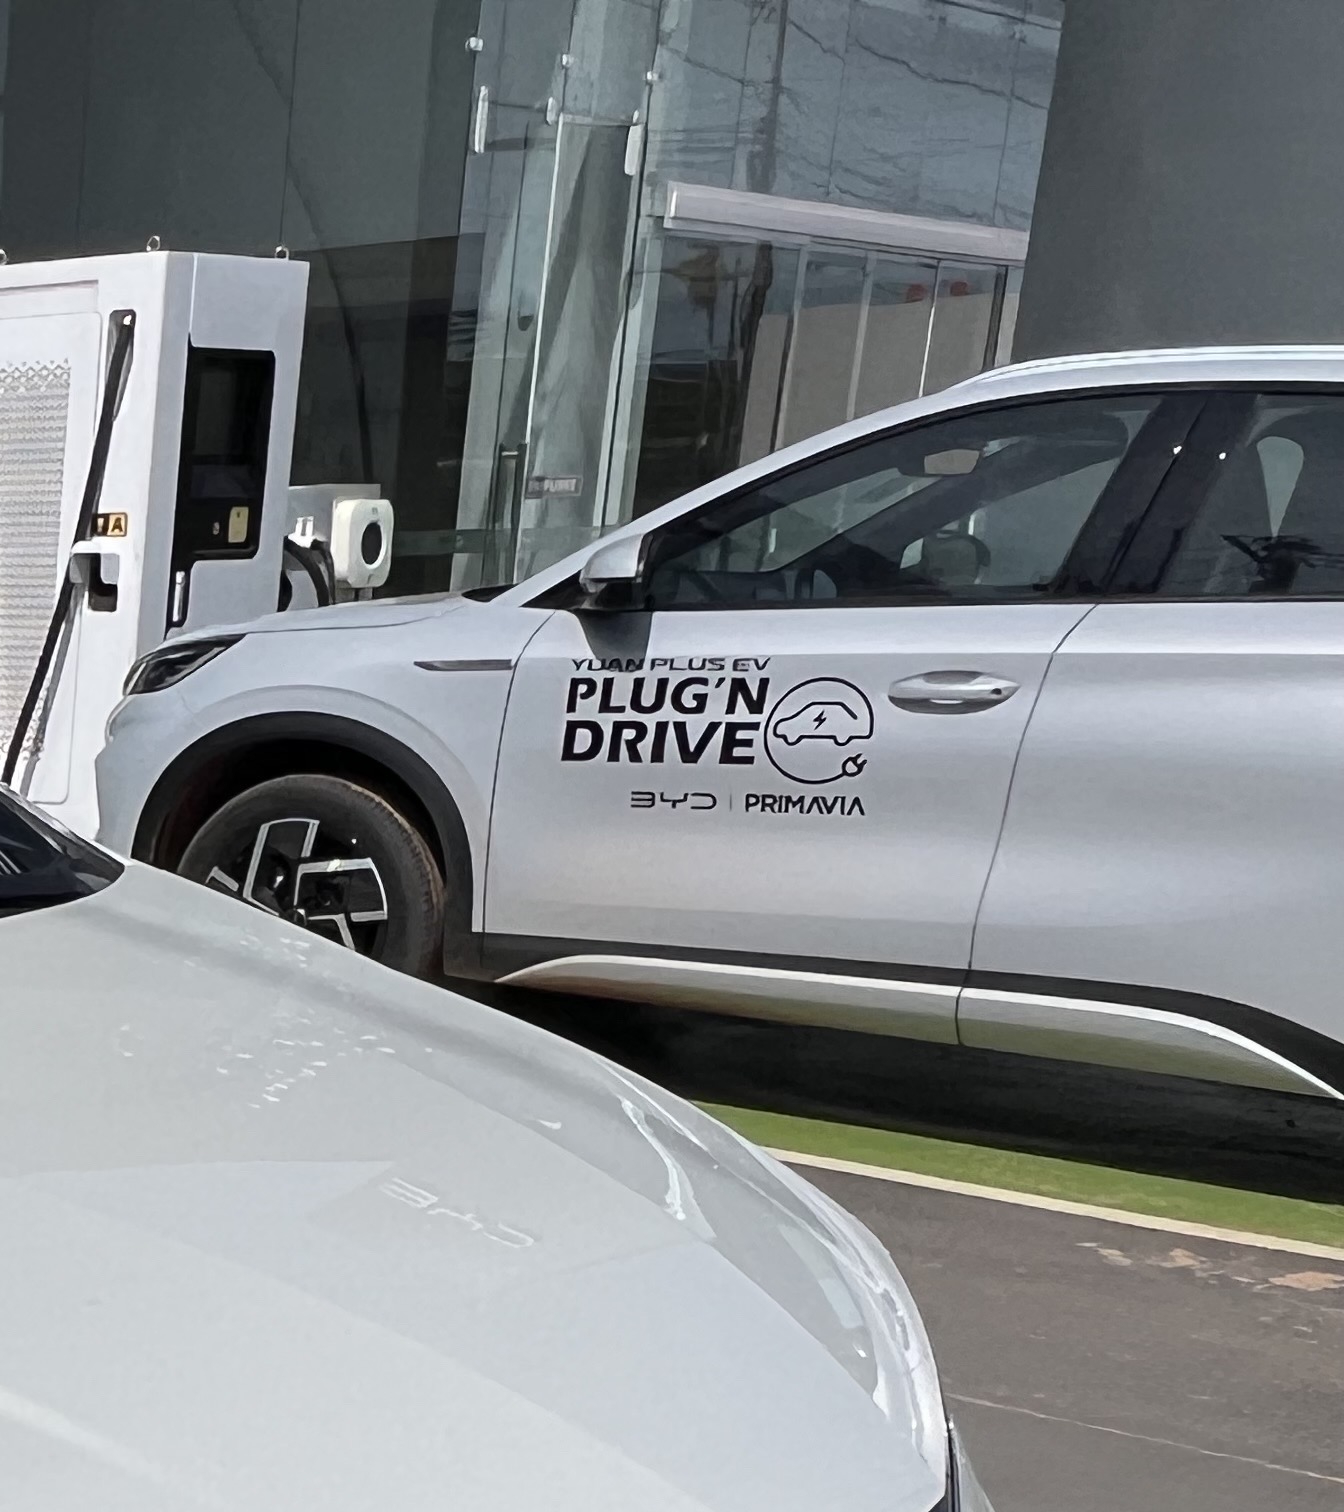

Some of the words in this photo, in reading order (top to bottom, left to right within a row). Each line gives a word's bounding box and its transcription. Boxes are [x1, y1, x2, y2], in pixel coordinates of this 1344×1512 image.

[650, 657, 725, 672] PLUS
[732, 657, 772, 672] EV
[565, 676, 770, 715] PLUG'N
[560, 719, 761, 765] DRIVE
[630, 790, 717, 810] BYD
[744, 793, 866, 816] PRIMAVIA
